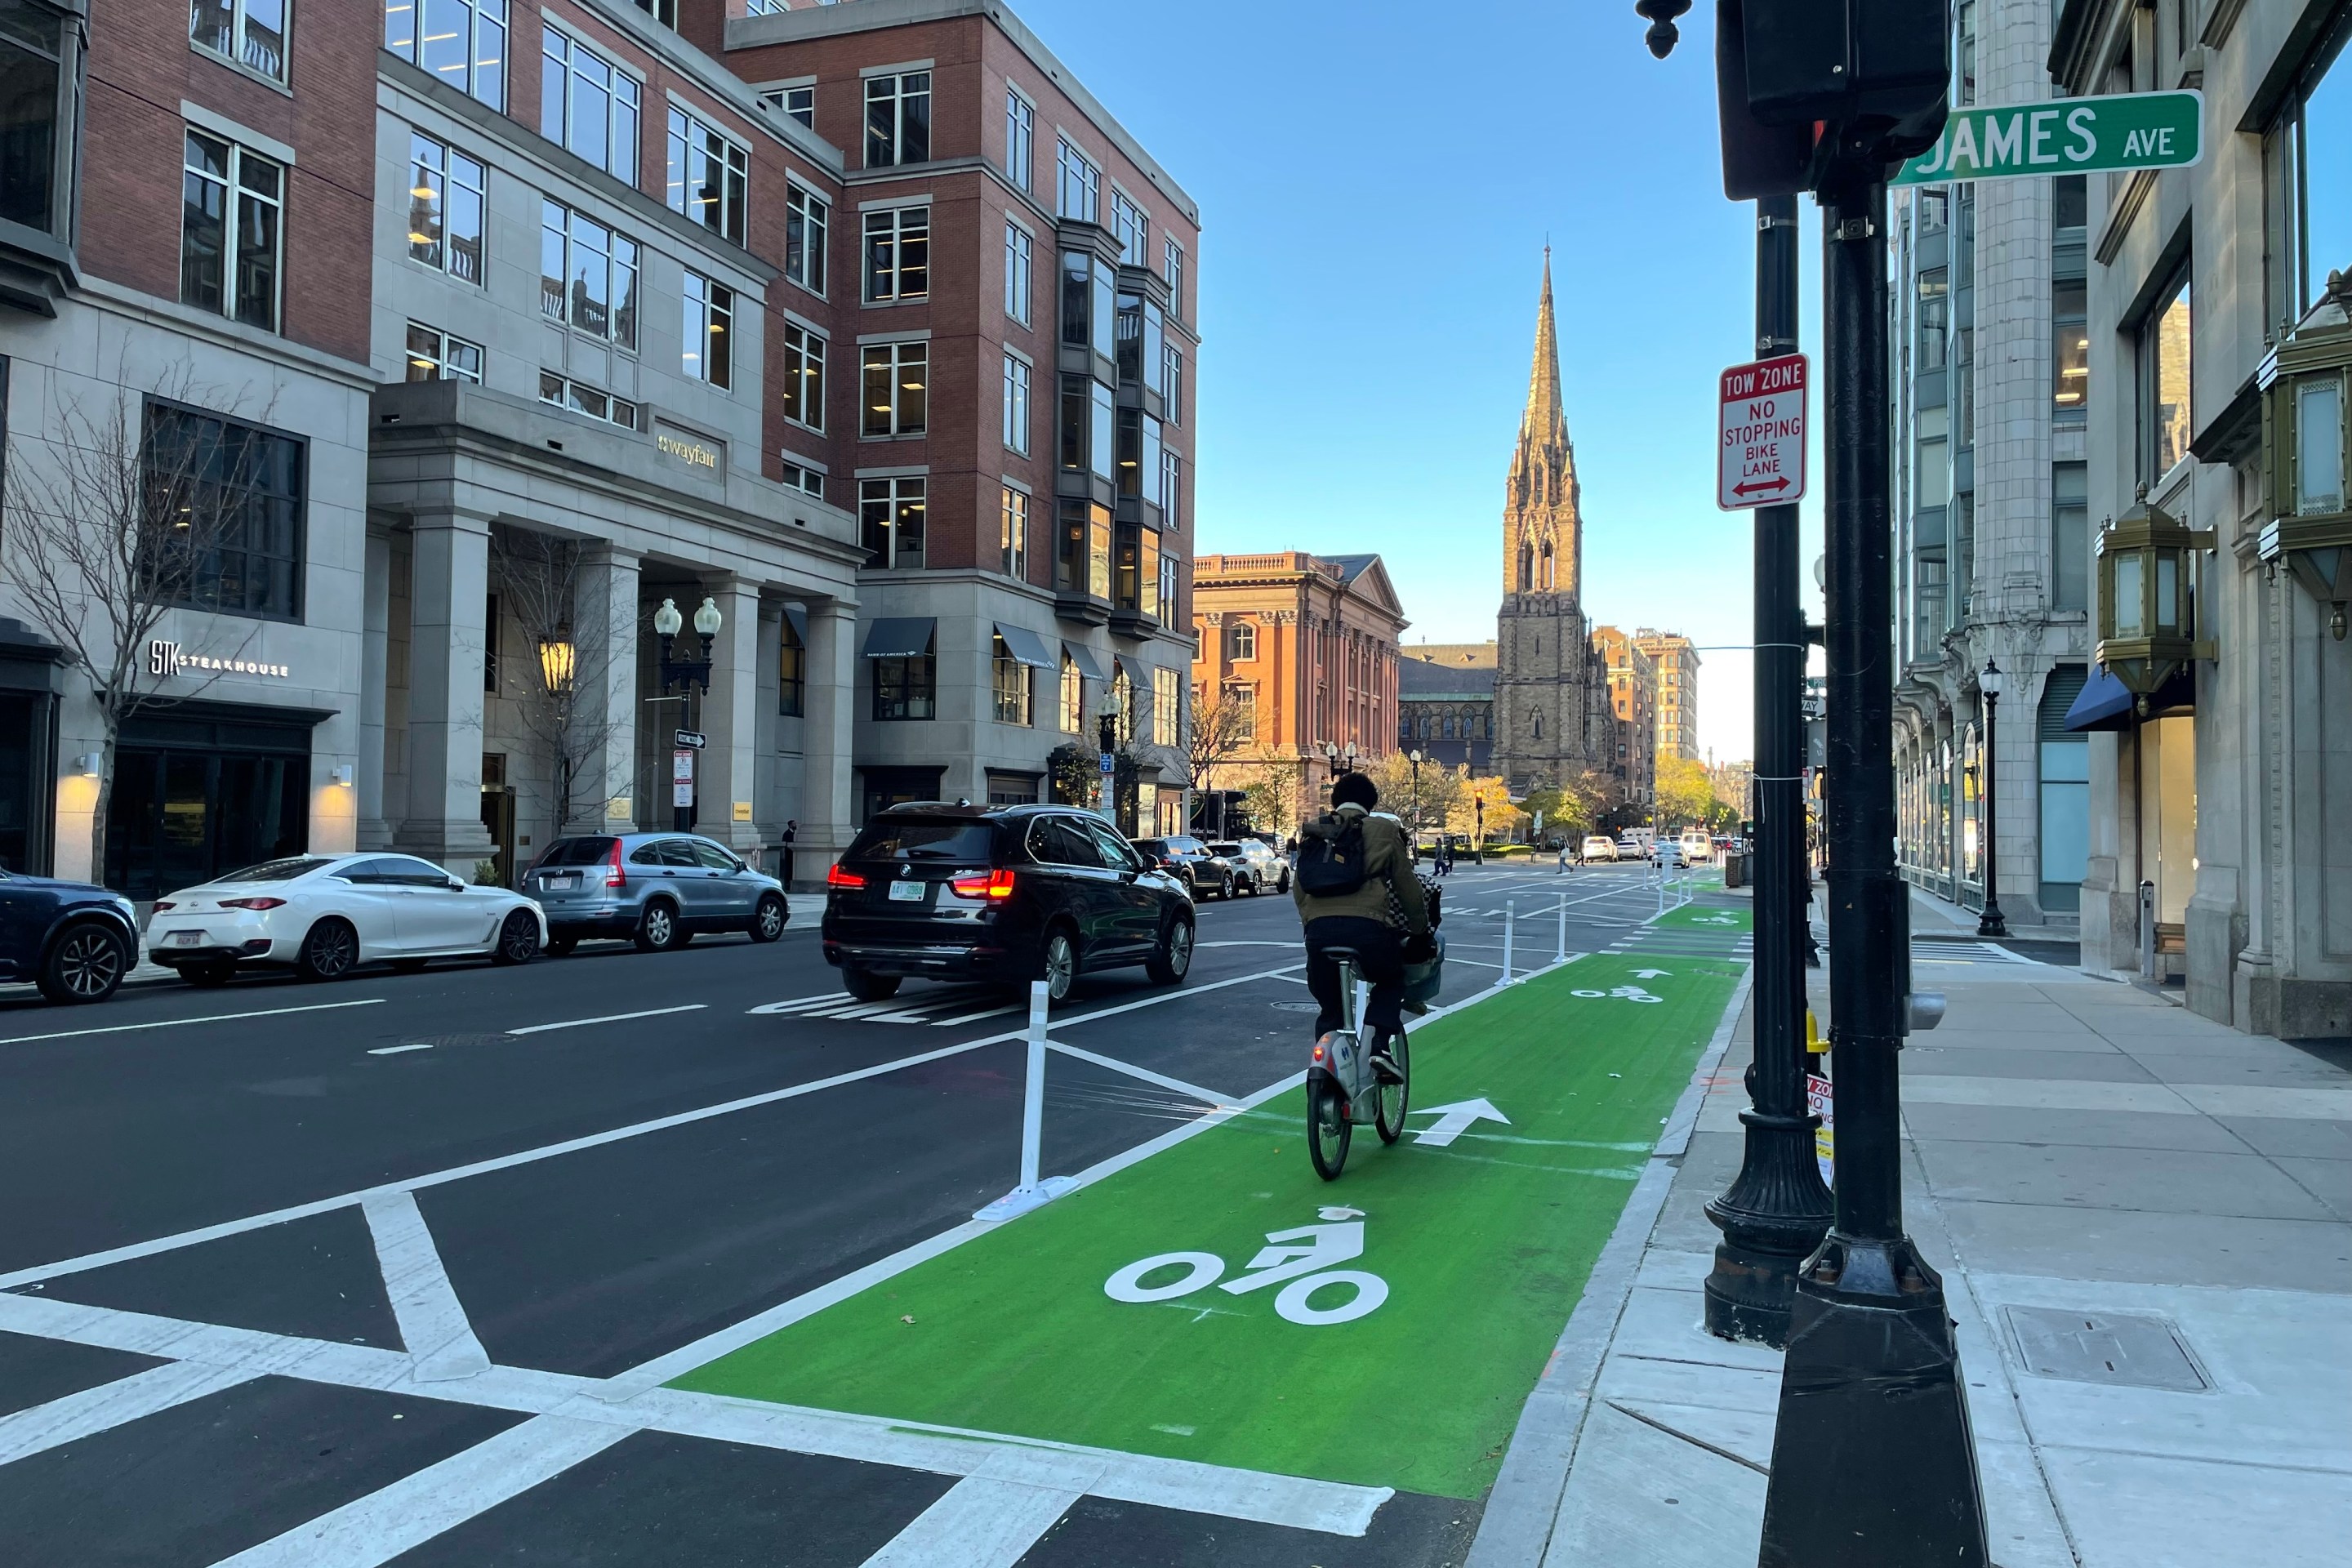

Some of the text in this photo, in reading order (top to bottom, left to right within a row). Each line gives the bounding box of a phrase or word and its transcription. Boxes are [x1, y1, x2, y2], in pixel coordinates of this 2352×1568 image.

[1915, 107, 2175, 174] JAMES AVE
[1726, 363, 1802, 397] TOW ZONE
[1749, 400, 1775, 421] NO
[1725, 417, 1801, 446] STOPPING
[668, 439, 716, 468] wayfair
[1746, 443, 1778, 461] BIKE
[1743, 459, 1780, 477] LANE
[150, 639, 288, 677] STK STEAKHOUSE
